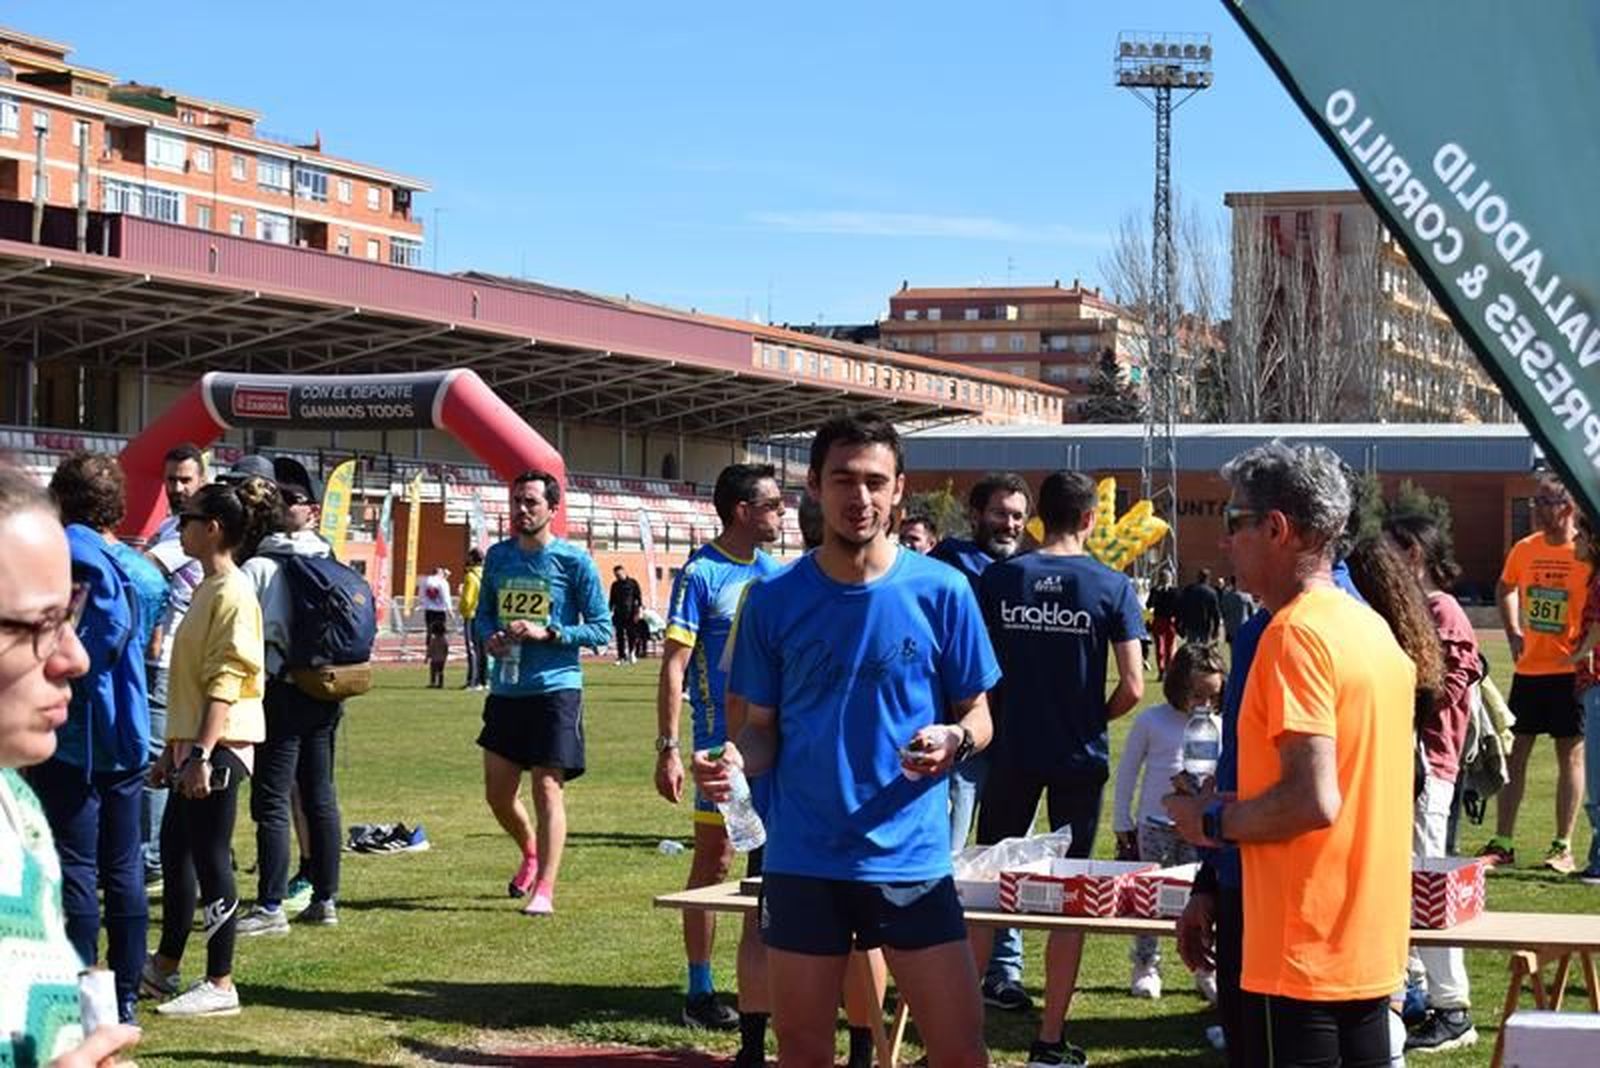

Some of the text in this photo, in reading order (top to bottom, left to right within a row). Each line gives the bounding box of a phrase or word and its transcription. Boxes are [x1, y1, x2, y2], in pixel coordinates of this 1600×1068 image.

[300, 384, 330, 398] CON
[332, 385, 347, 398] EL
[351, 384, 413, 398] DEPORTE
[300, 404, 415, 418] GANAMOS TODOS
[502, 592, 543, 614] 422
[1530, 600, 1560, 620] 361
[1001, 600, 1091, 628] triatlon
